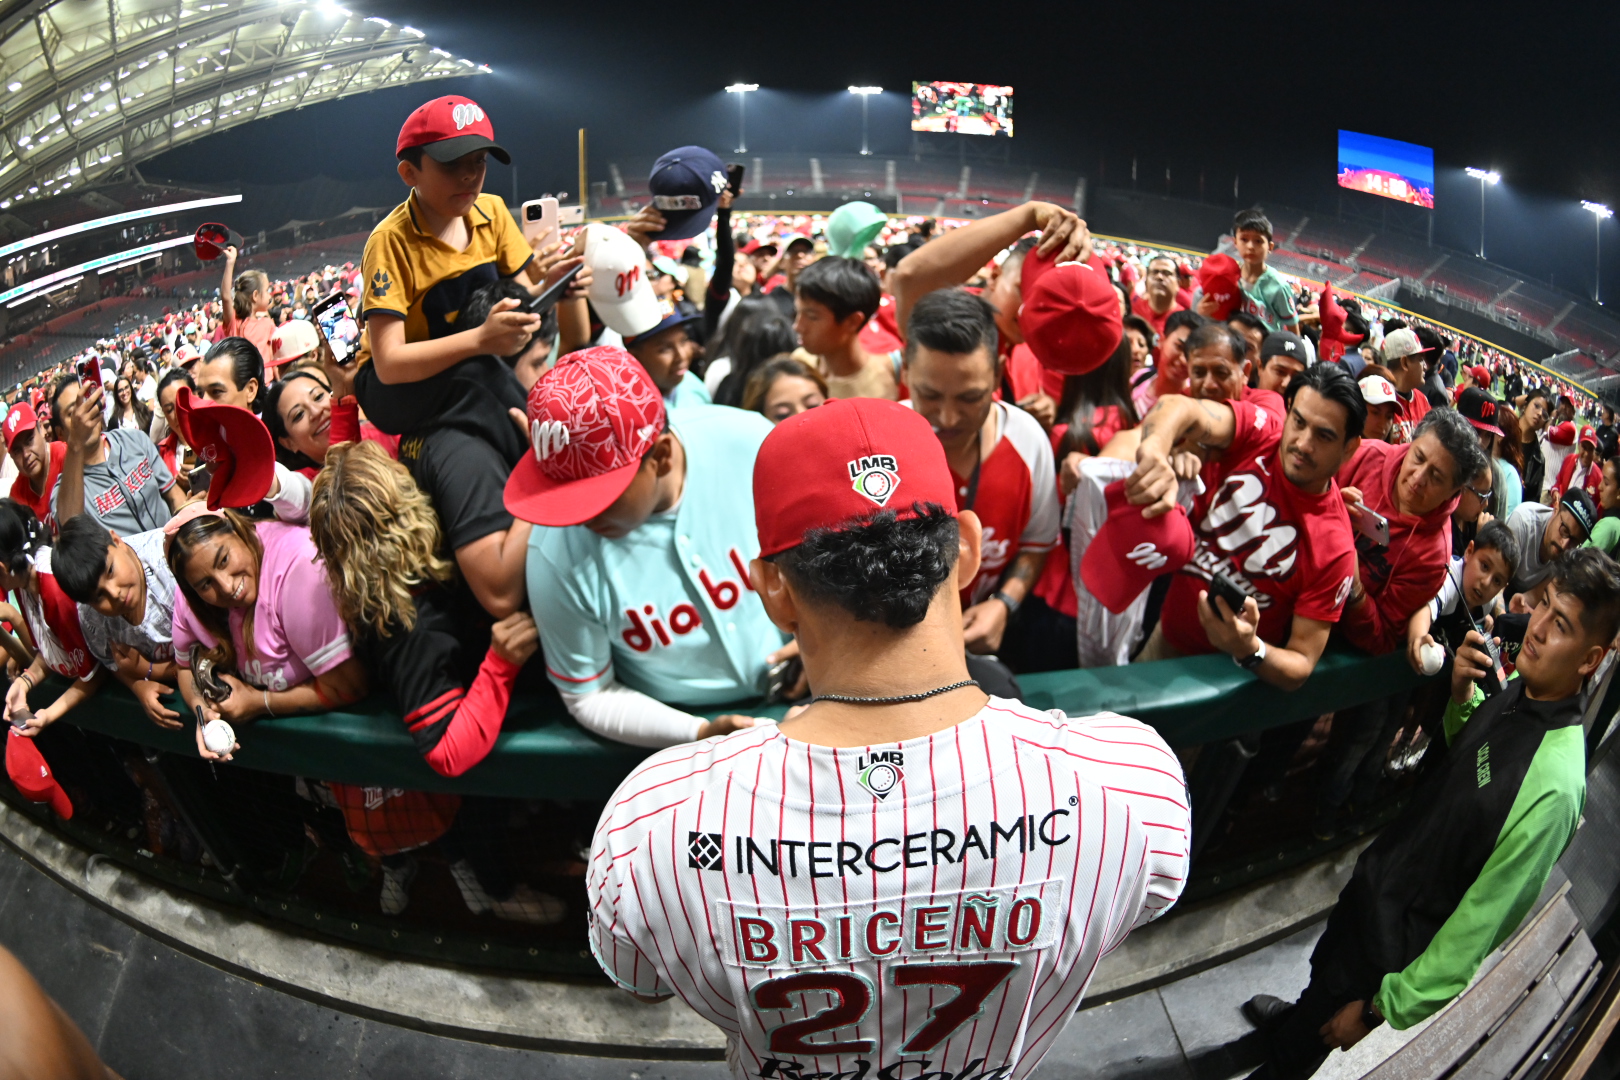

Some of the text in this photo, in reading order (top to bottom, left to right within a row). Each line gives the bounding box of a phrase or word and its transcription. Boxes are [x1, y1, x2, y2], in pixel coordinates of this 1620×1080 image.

[850, 456, 897, 478] LMB
[858, 750, 904, 772] LMB
[735, 892, 1043, 965] BRICEÑO
[749, 960, 1021, 1056] 27
